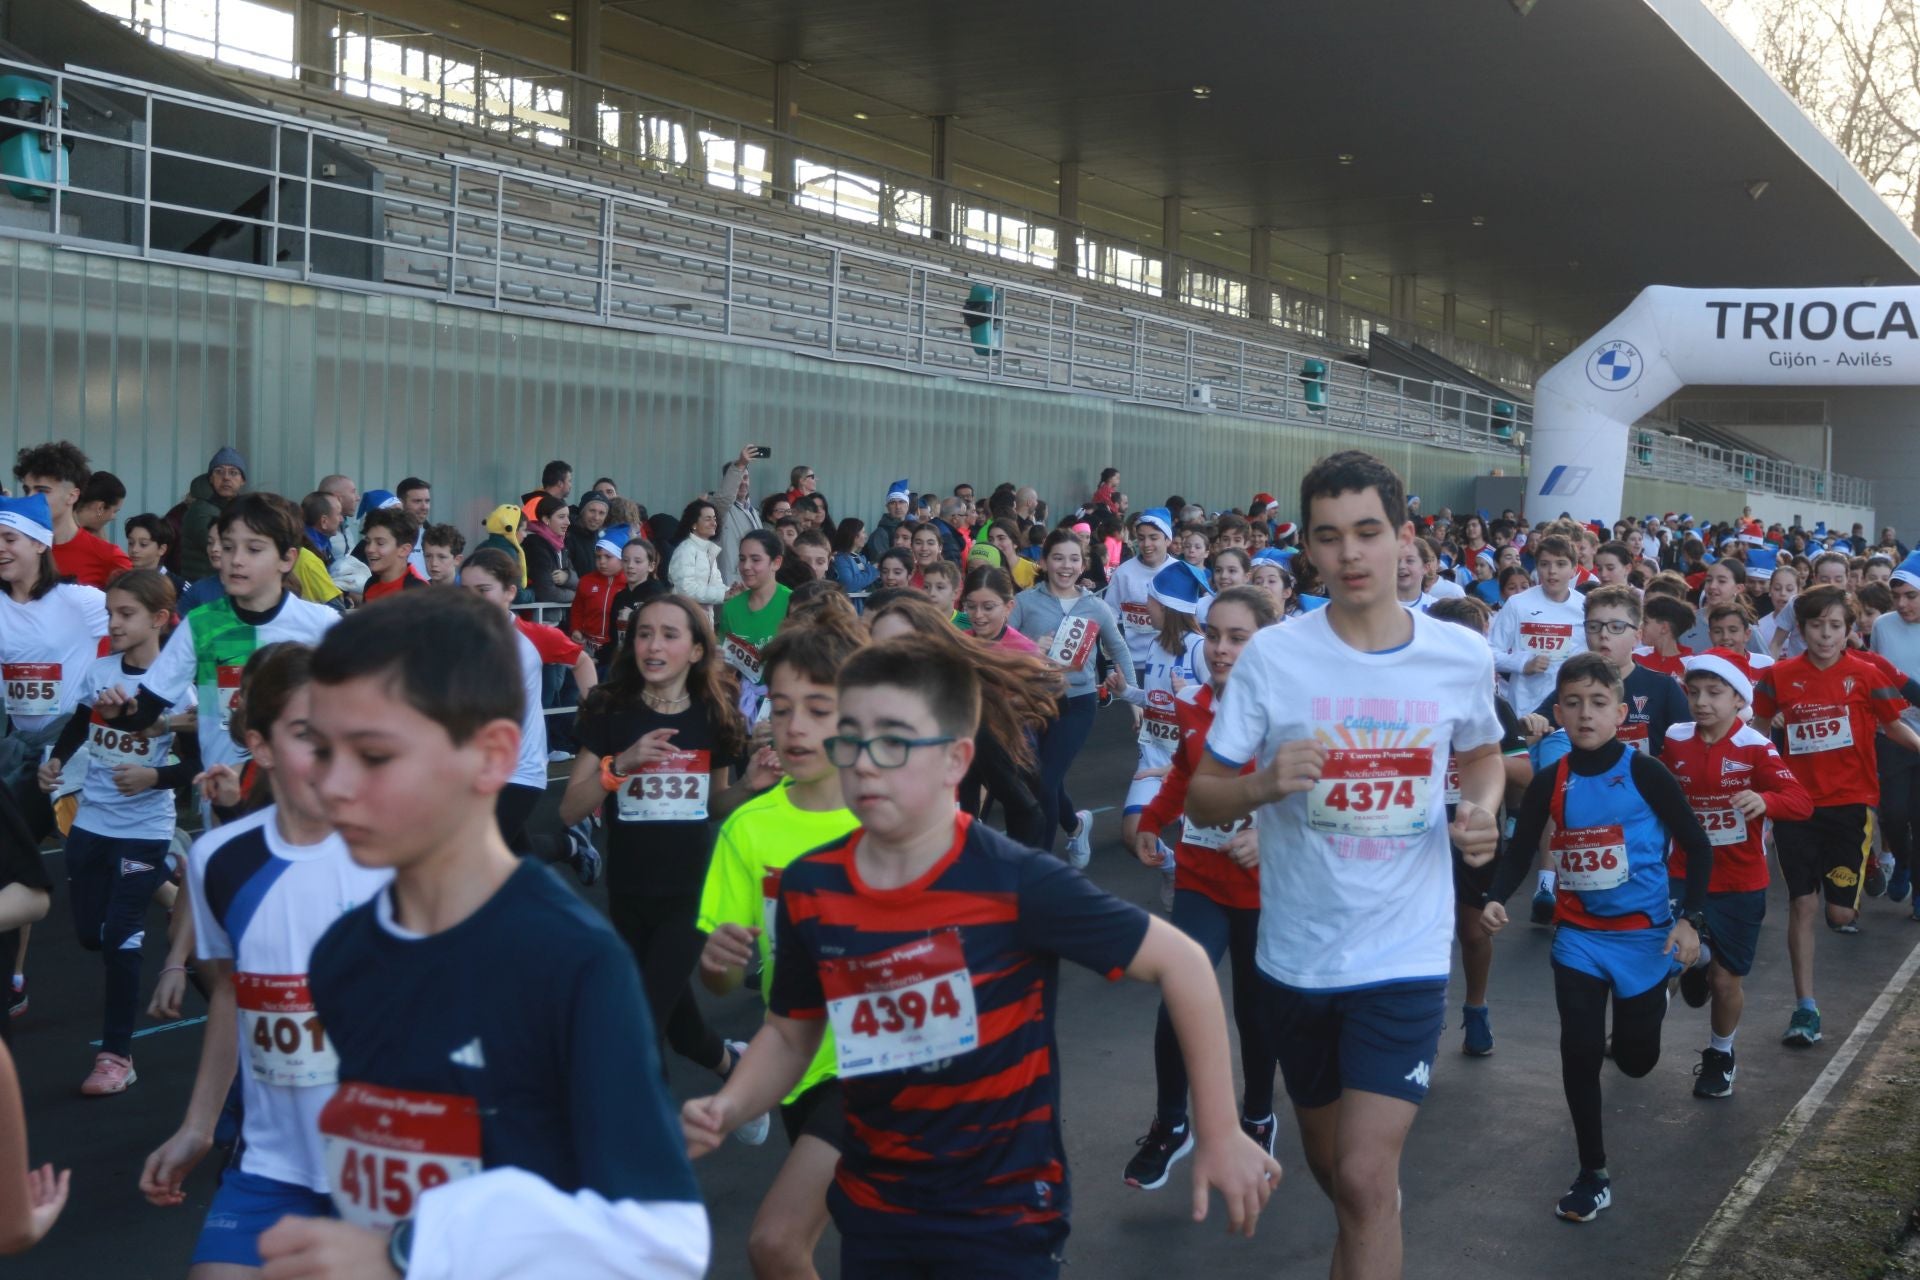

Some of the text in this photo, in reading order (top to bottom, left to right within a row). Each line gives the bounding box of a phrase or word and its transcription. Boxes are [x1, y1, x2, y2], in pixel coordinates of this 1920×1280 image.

[1705, 301, 1919, 341] TRIOCA
[1597, 343, 1636, 357] BMW
[1769, 351, 1816, 369] Gijón
[1836, 351, 1892, 367] Avilés
[1060, 618, 1085, 661] 4030
[1528, 636, 1564, 650] 4157
[8, 682, 55, 700] 4055
[94, 728, 150, 756] 4083
[1146, 721, 1180, 740] 4026
[1796, 720, 1840, 740] 4159
[627, 775, 699, 800] 4332
[1324, 779, 1415, 812] 4374
[1695, 812, 1737, 831] 225
[1561, 848, 1618, 873] 4236
[851, 980, 960, 1037] 4394
[253, 1016, 325, 1055] 401
